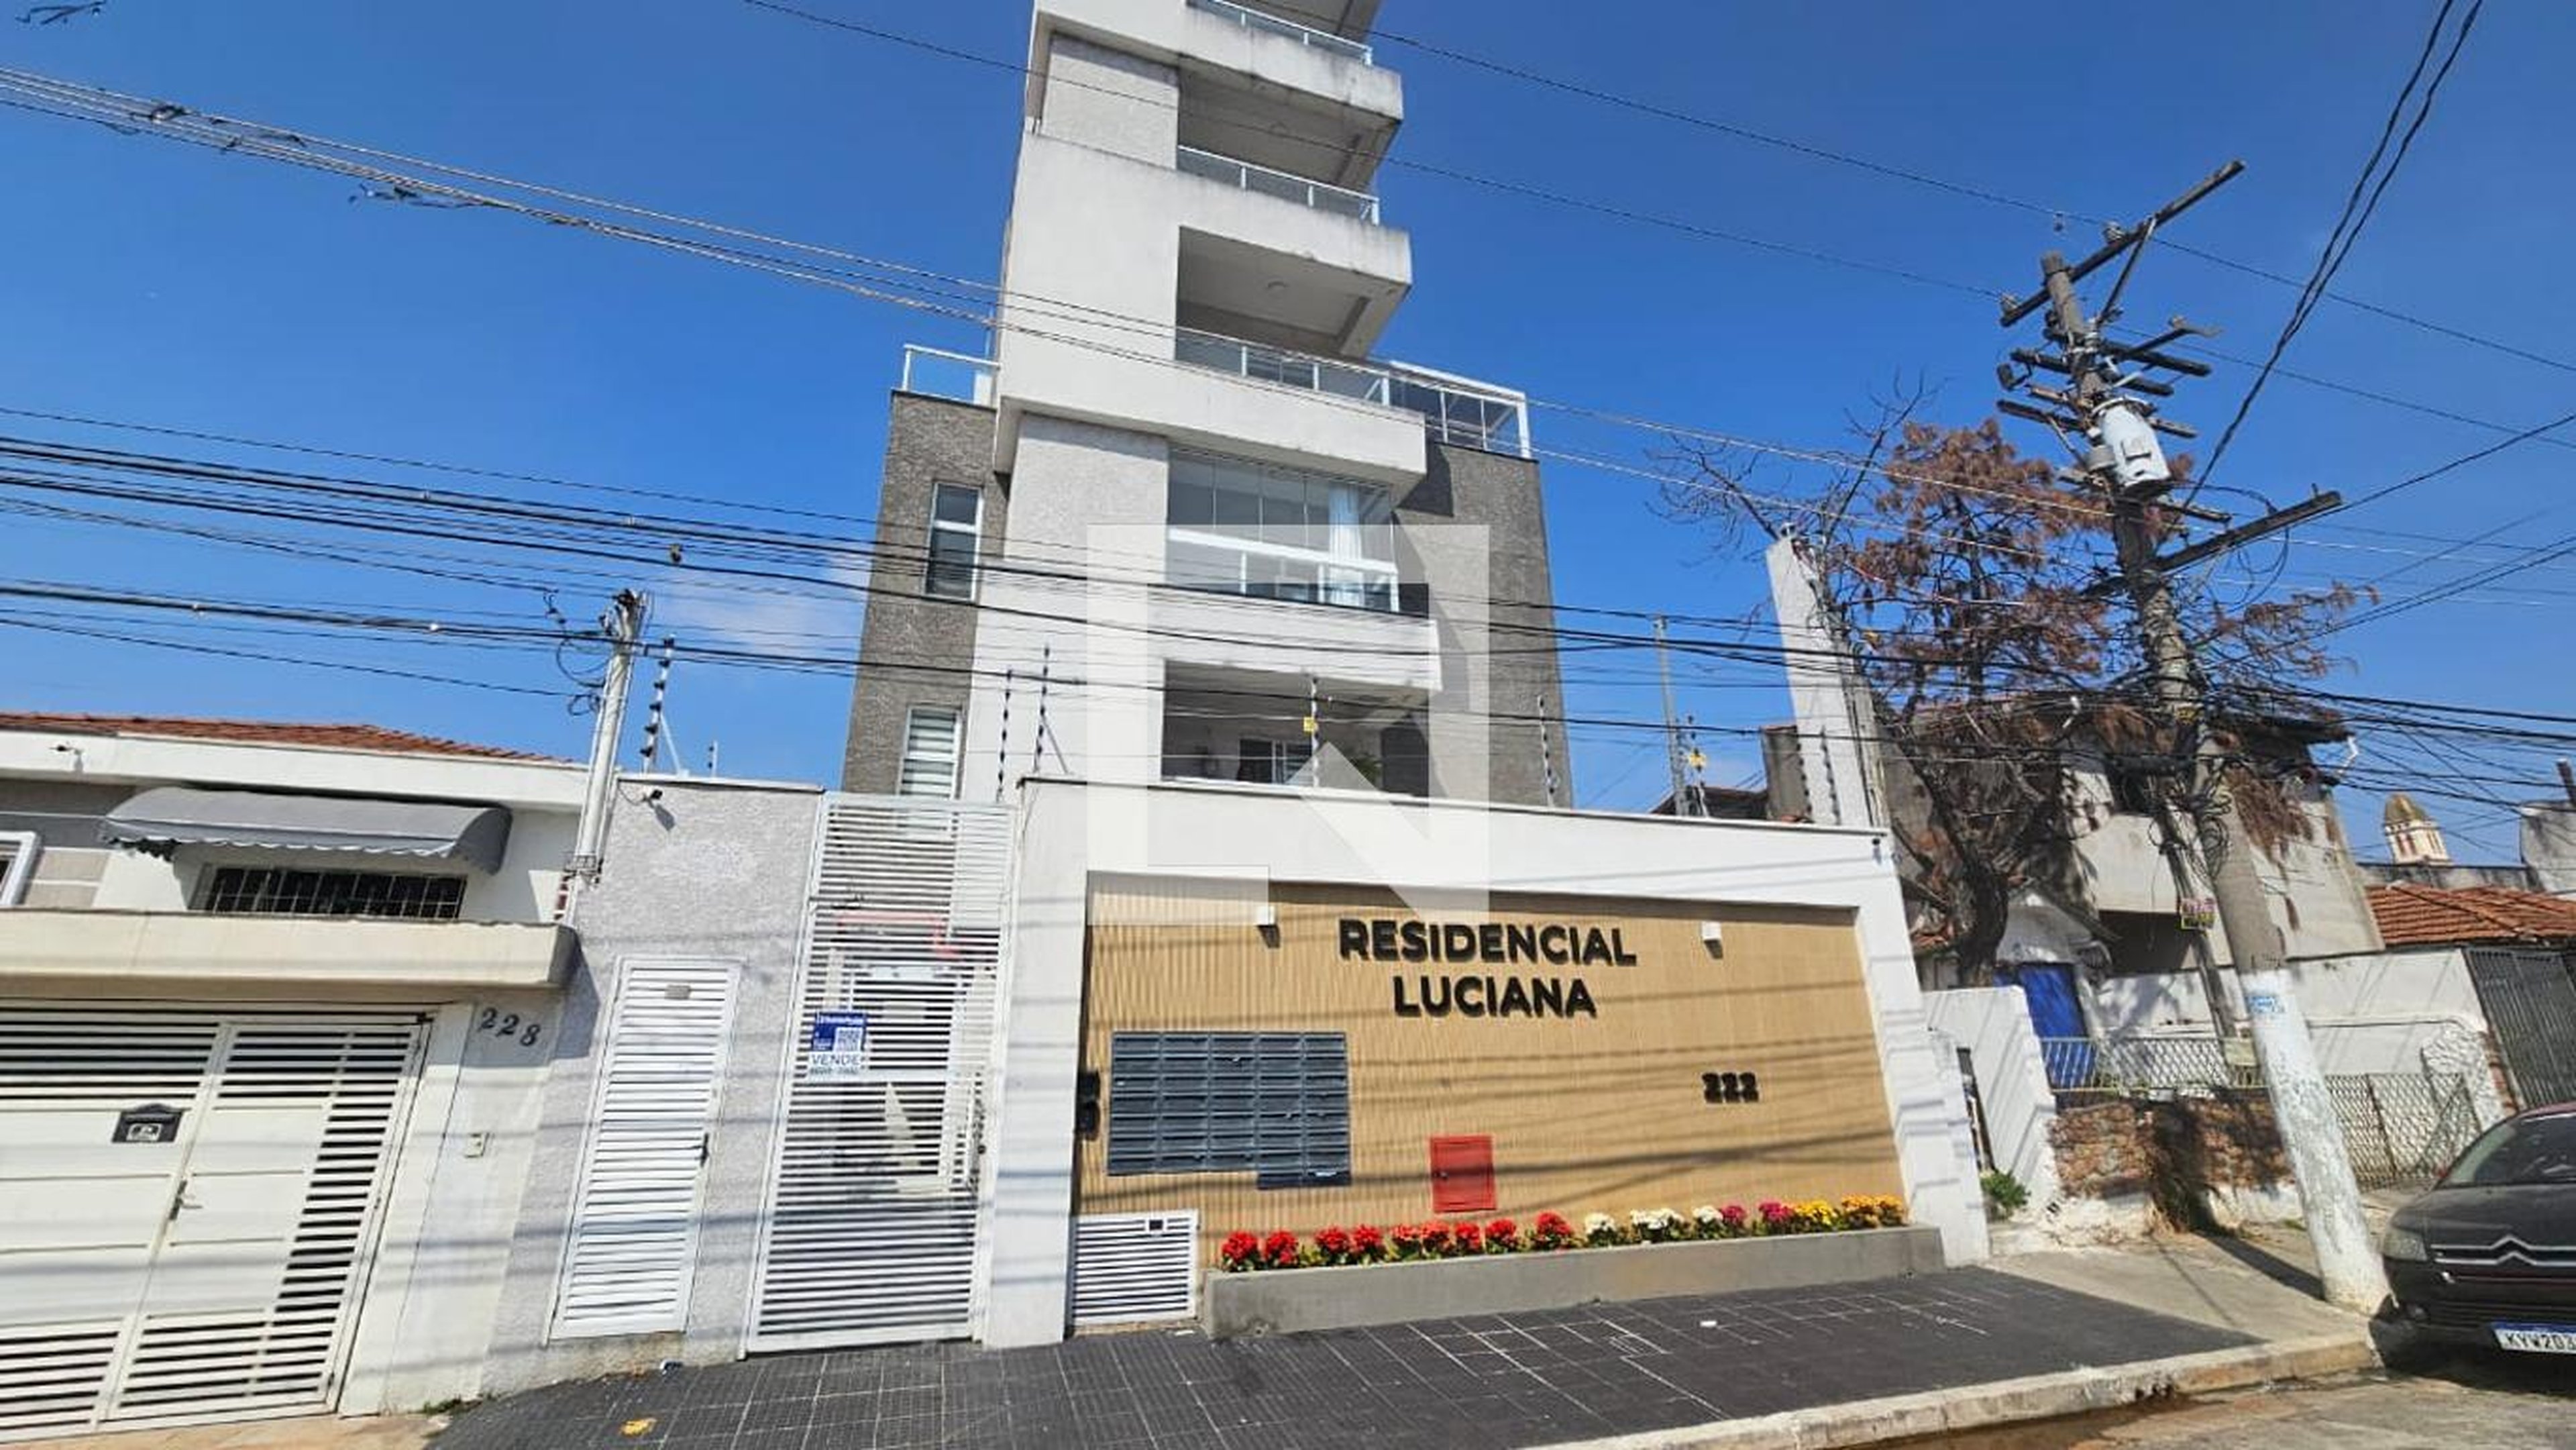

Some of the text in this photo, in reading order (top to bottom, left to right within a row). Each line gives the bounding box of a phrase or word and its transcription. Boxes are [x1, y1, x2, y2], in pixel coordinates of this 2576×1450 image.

[1339, 919, 1637, 966] RESIDENCIAL
[1393, 976, 1597, 1018] LUCIANA
[477, 1007, 540, 1047] 228
[811, 1054, 860, 1066] VENDE
